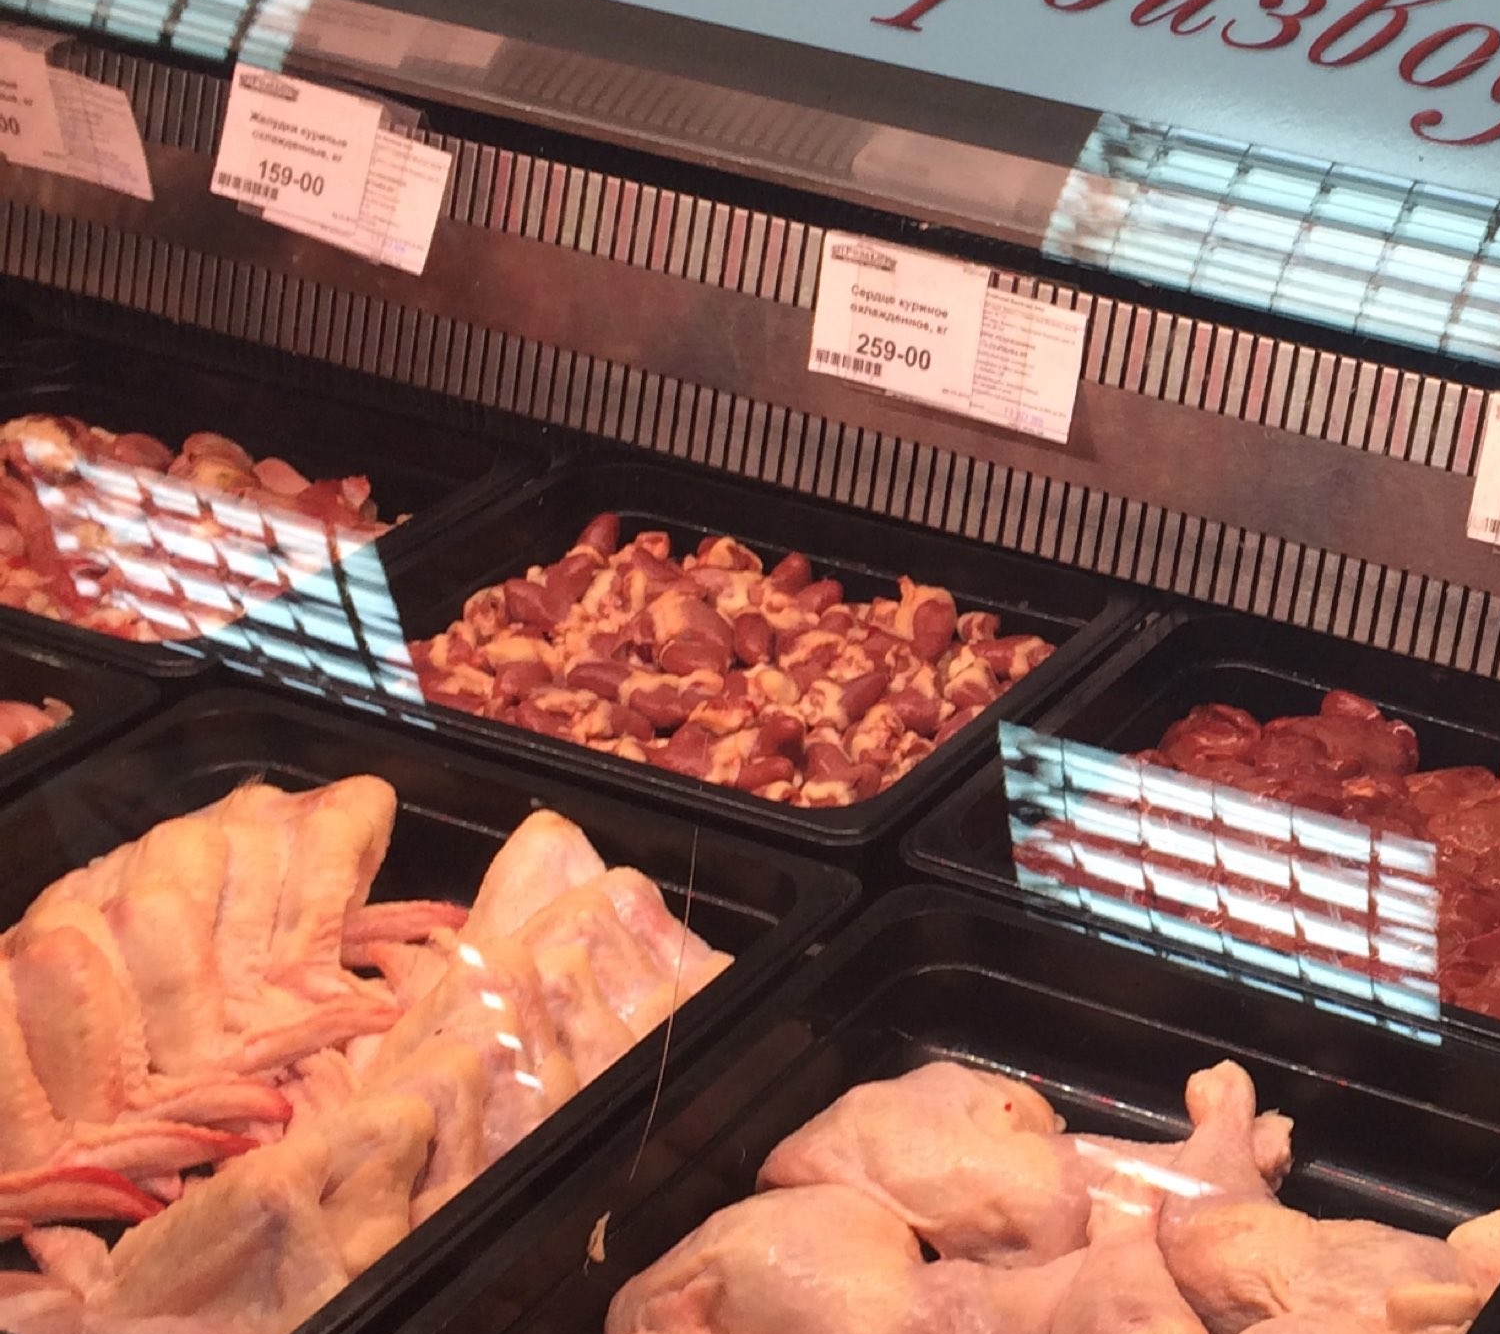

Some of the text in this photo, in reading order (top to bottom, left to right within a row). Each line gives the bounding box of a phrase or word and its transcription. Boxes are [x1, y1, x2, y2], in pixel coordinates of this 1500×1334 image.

[258, 159, 325, 197] 159-00
[849, 302, 949, 336] охлажденное, кг
[851, 283, 949, 319] Сердце куриное
[856, 332, 932, 371] 259-00
